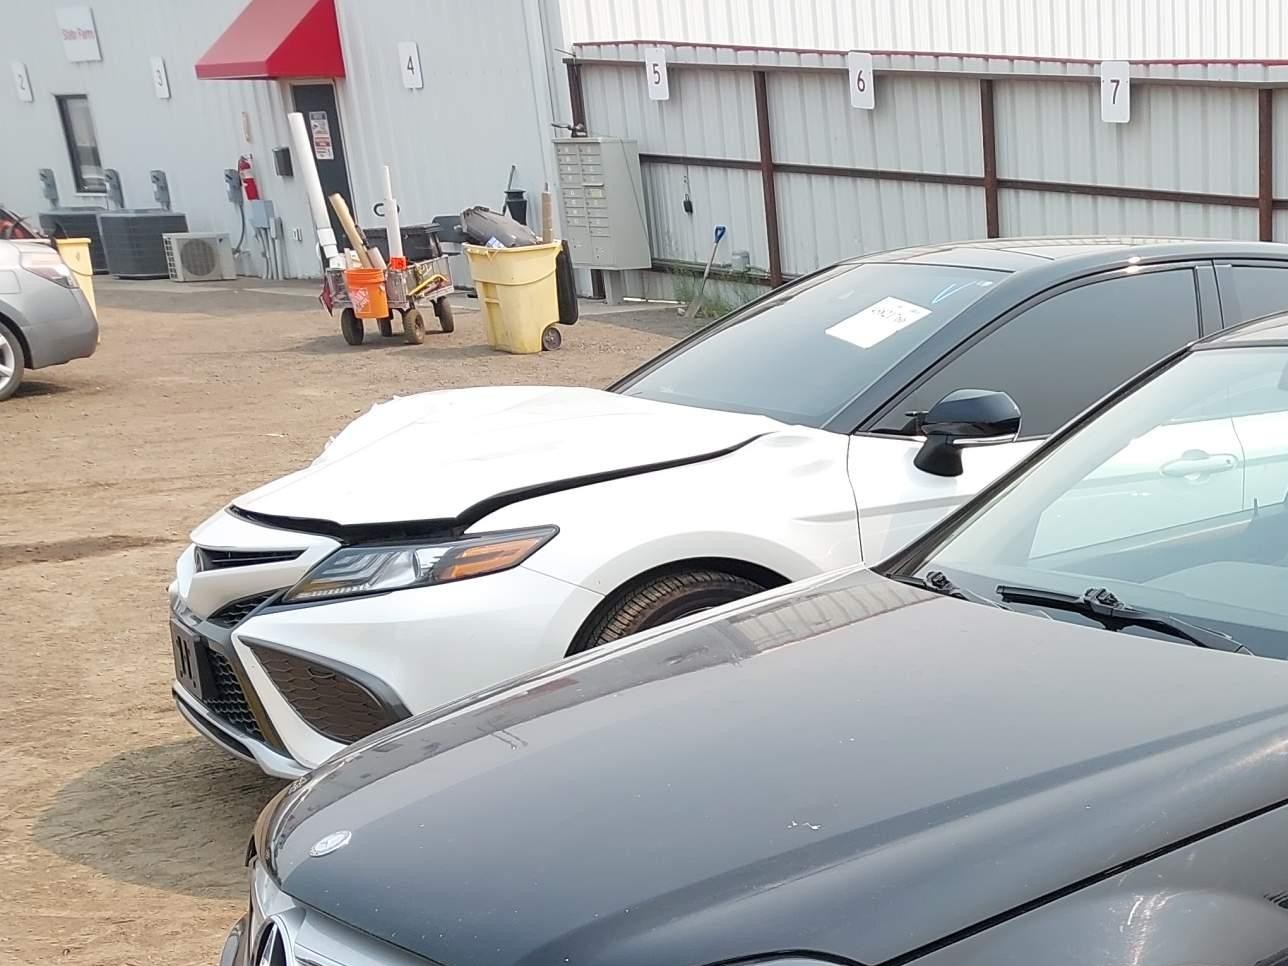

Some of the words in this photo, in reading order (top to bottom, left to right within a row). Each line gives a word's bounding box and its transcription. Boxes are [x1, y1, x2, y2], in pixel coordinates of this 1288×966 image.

[407, 55, 415, 75] 4
[652, 63, 662, 85] 5
[17, 73, 26, 90] 2
[155, 69, 164, 87] 3
[856, 70, 866, 92] 6
[1109, 79, 1121, 105] 7
